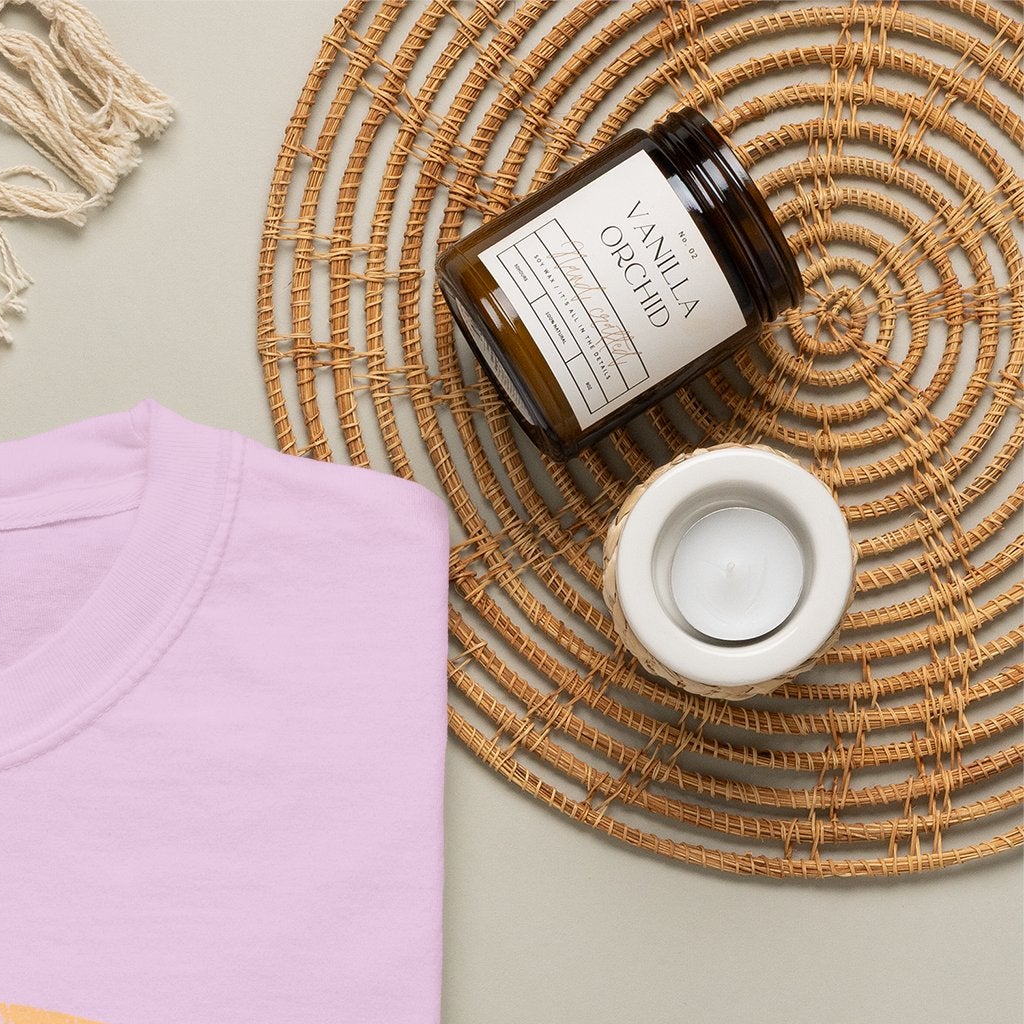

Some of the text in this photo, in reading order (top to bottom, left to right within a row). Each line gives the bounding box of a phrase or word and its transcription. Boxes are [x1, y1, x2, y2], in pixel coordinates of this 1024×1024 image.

[601, 225, 670, 327] ORCHID
[627, 200, 700, 318] VANILLA
[688, 248, 698, 259] 02
[534, 254, 544, 267] SOY
[544, 269, 554, 283] WAX
[569, 308, 579, 322] ALL
[578, 324, 586, 333] IN
[585, 335, 595, 350] THE
[593, 351, 611, 380] DETAILS
